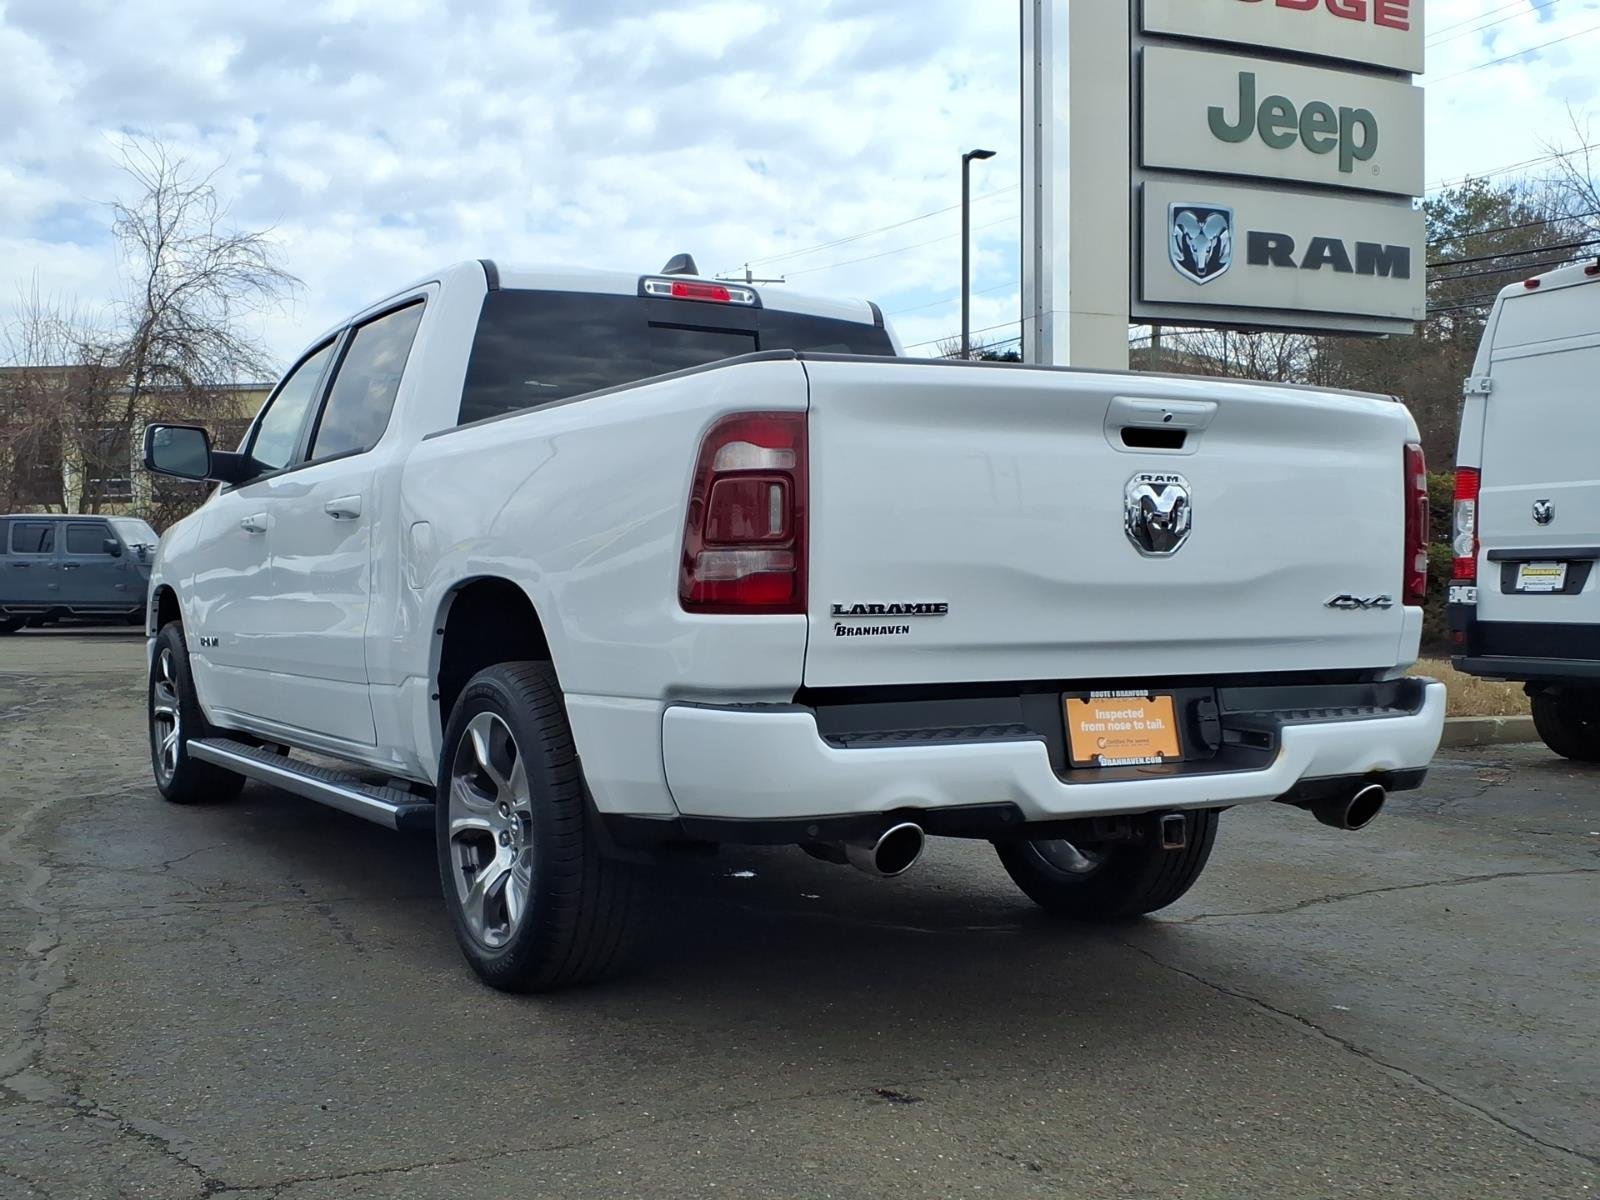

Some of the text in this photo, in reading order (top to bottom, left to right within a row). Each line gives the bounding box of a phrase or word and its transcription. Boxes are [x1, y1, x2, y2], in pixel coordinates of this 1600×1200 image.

[1207, 71, 1378, 173] Jeep
[1246, 230, 1410, 280] RAM
[1140, 474, 1179, 482] RAM
[832, 602, 949, 617] LARAMIE
[1090, 690, 1111, 698] ROUTE
[1116, 689, 1149, 697] BRANFORD
[1095, 707, 1144, 721] Inspected
[1081, 718, 1165, 732] from nose to tail.
